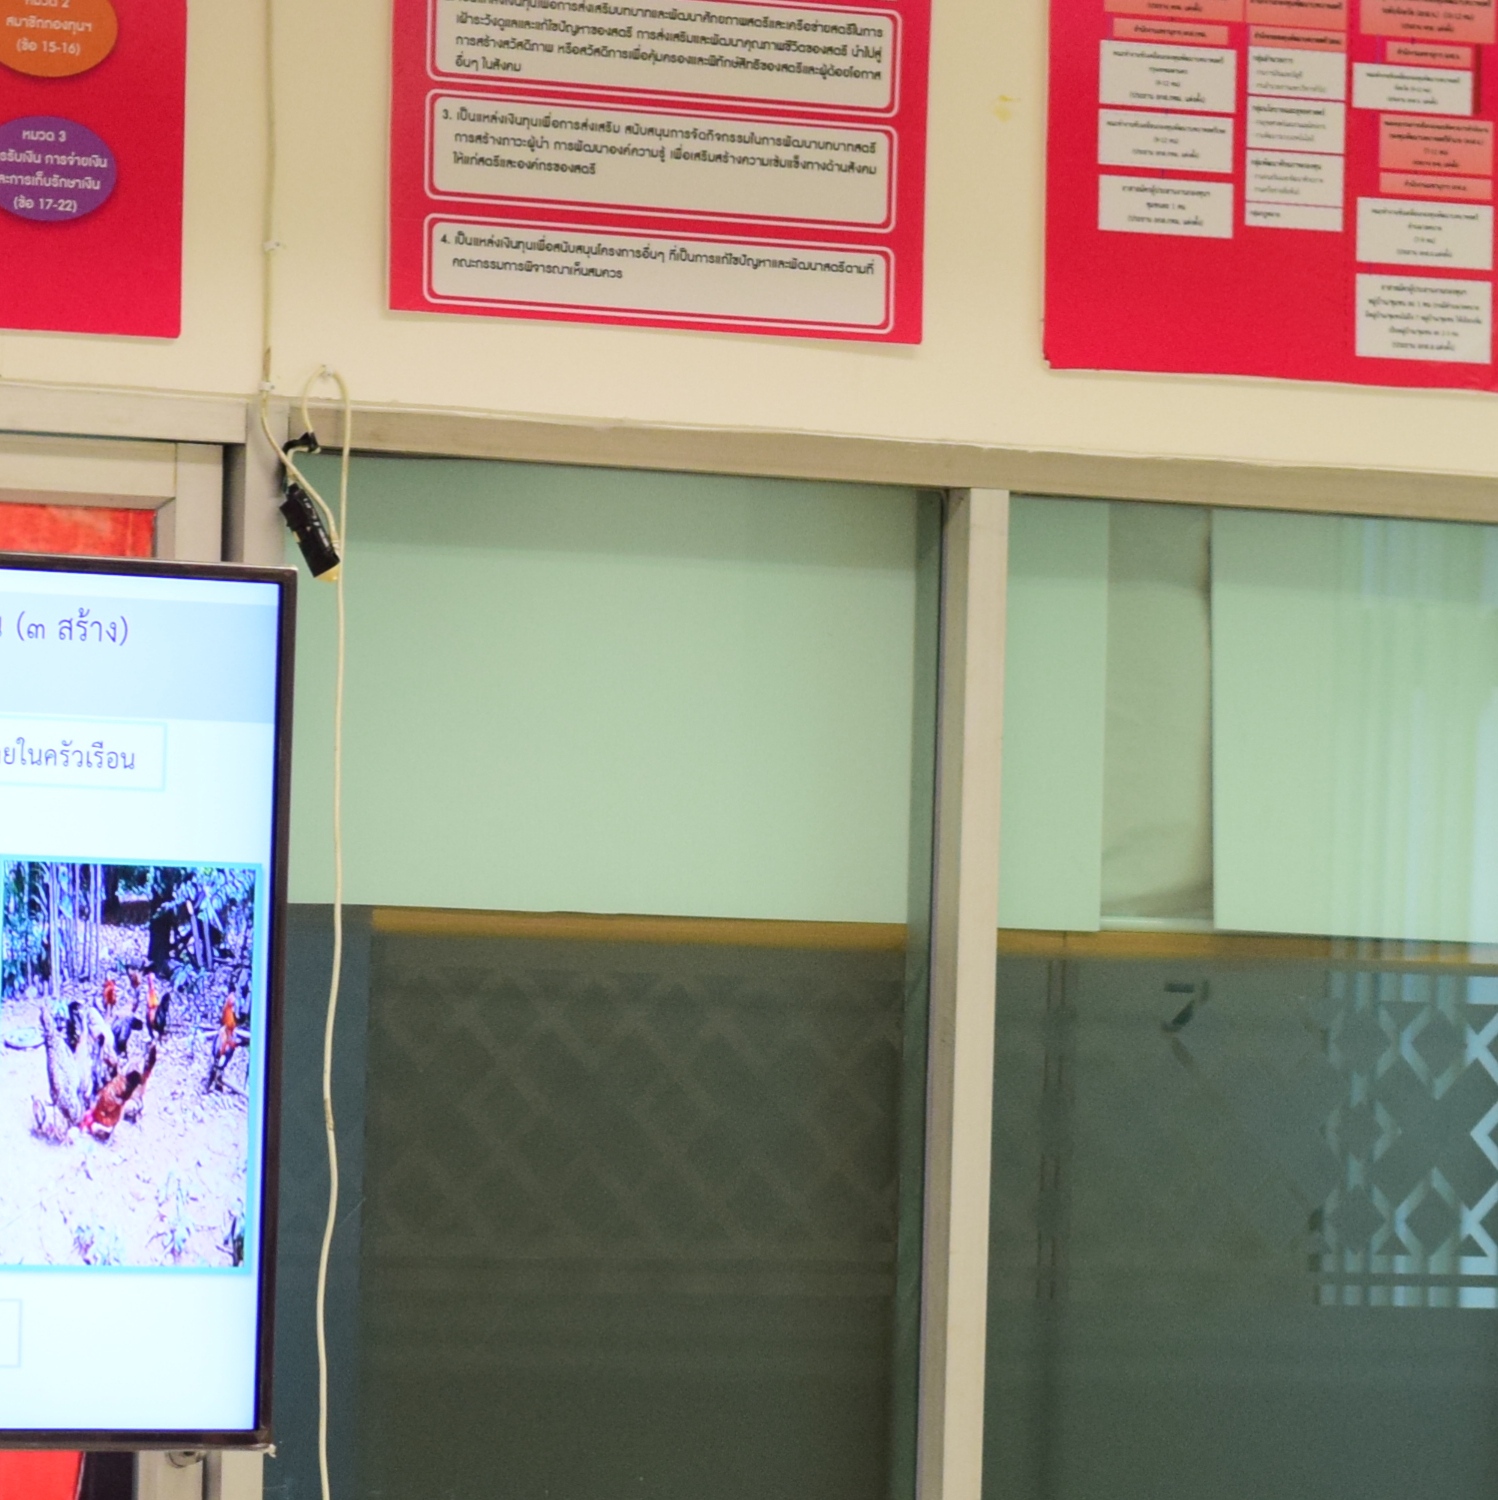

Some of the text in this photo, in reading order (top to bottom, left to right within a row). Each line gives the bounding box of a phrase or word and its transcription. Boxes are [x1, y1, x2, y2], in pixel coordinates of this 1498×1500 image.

[42, 41, 81, 56] 15-16)
[442, 109, 452, 120] 3.
[22, 130, 67, 142] หมวด 3
[45, 151, 108, 168] การจ่ายเงิน
[38, 198, 78, 213] 17-22)
[440, 234, 450, 245] 4.
[16, 610, 47, 642] (๓
[57, 606, 129, 648] สร้าง)
